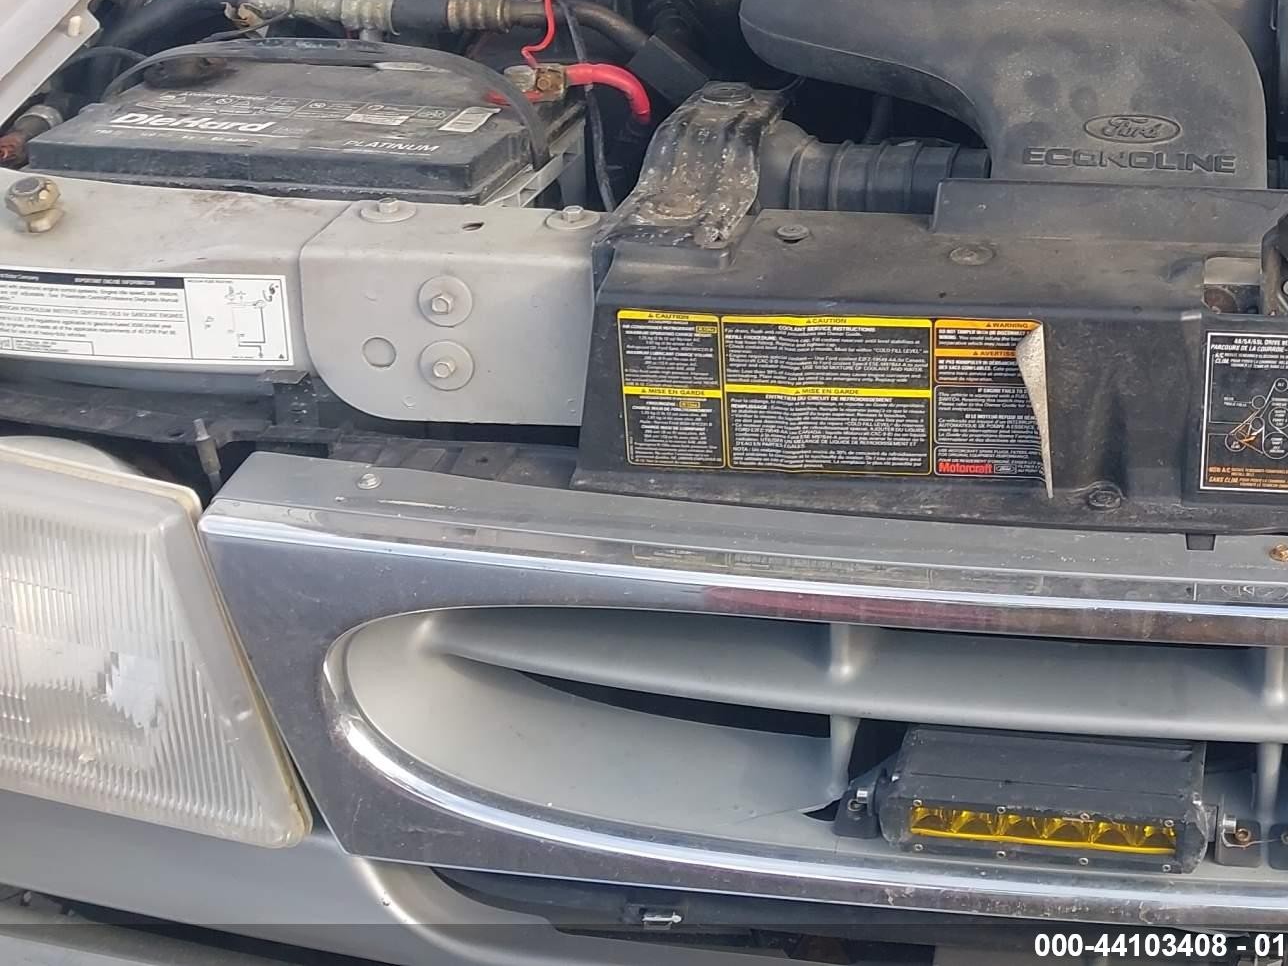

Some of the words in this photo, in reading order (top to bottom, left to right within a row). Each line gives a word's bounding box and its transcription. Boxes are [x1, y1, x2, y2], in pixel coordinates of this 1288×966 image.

[109, 112, 276, 132] DieHard
[1101, 118, 1163, 139] Ford
[343, 140, 440, 153] PLATINUM
[1022, 147, 1237, 174] ECONOLINE
[938, 462, 993, 474] Motorcraft
